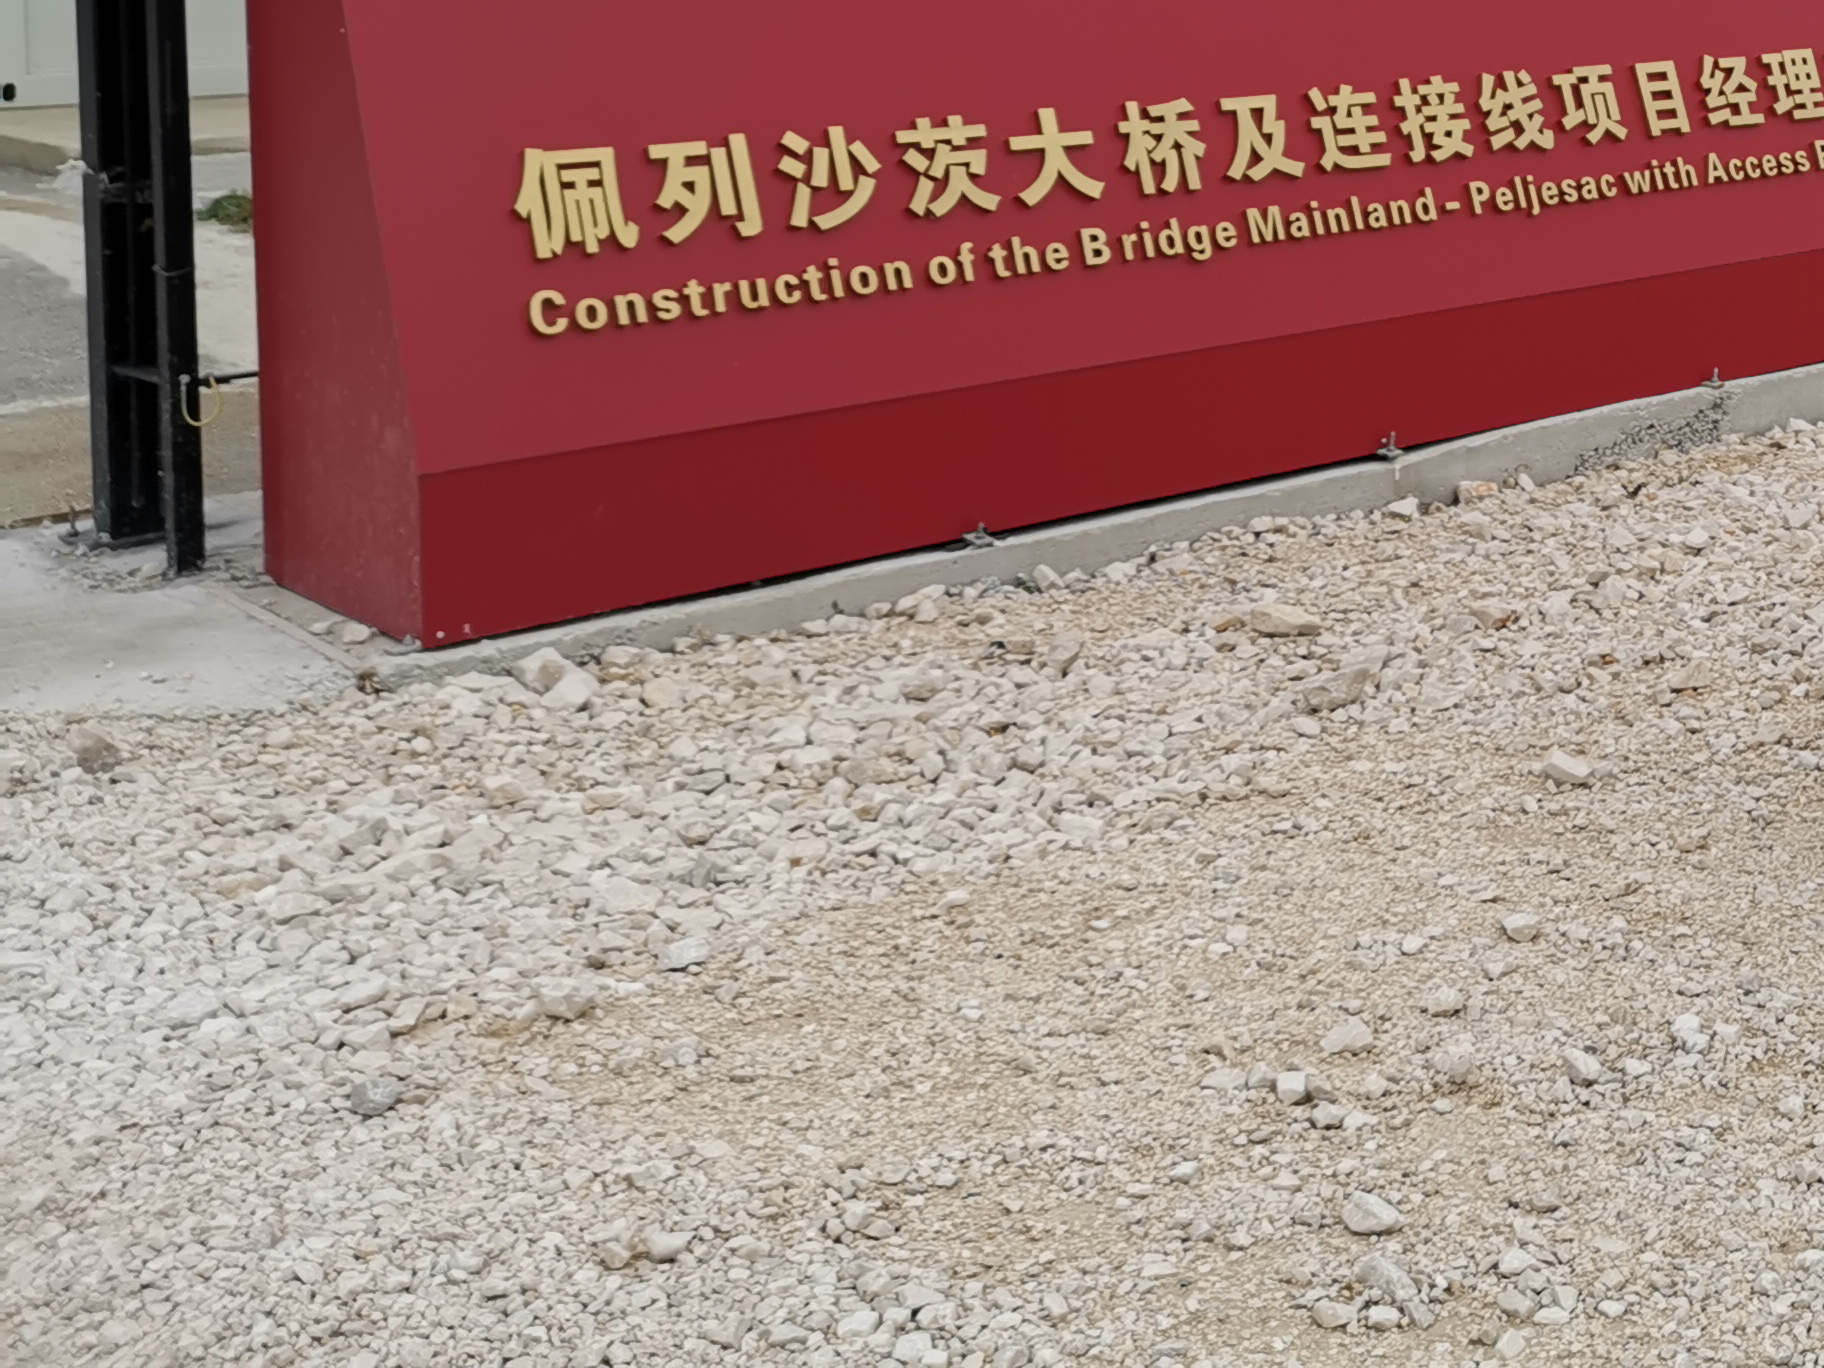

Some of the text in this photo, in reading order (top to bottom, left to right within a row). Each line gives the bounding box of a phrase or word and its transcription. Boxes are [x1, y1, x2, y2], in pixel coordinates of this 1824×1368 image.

[528, 257, 913, 337] Construction
[928, 240, 977, 288] of
[987, 234, 1070, 280] the
[1078, 215, 1239, 266] Bridge
[1245, 185, 1437, 247] Mainland
[1469, 174, 1619, 216] Peljesac
[1626, 156, 1699, 195] with
[1706, 146, 1811, 186] Access
